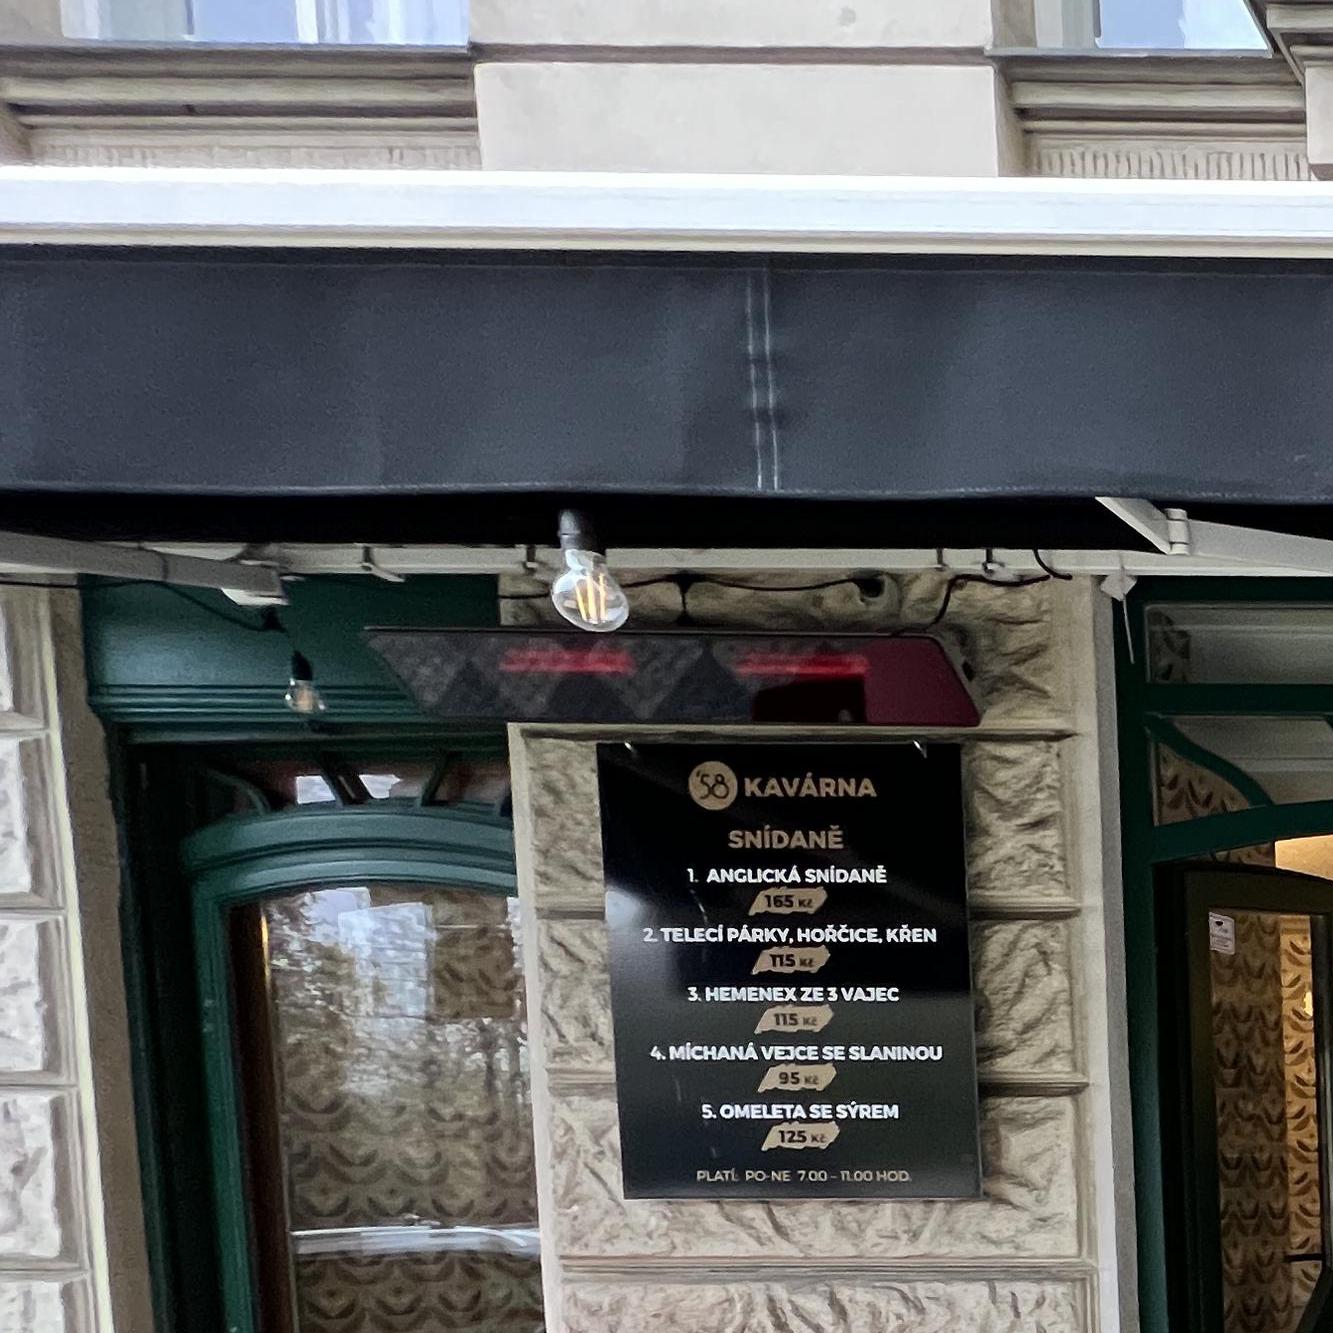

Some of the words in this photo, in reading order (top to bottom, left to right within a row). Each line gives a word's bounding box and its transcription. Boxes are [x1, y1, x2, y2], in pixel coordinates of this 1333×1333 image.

[744, 773, 877, 797] KAVÁRNA
[729, 825, 844, 849] SNÍDANĚ
[687, 869, 698, 883] 1.
[707, 866, 800, 883] ANGLICKÁ
[805, 865, 886, 882] SNÍDANĚ
[765, 895, 794, 908] 165
[644, 929, 658, 943] 2.
[661, 925, 723, 943] TELECÍ
[728, 925, 794, 945] PÁRKY,
[887, 925, 937, 943] KŘEN
[770, 954, 796, 968] 115
[688, 987, 701, 1001] 3.
[705, 987, 797, 1001] HEMENEX
[800, 987, 824, 1001] ZE
[827, 987, 839, 1001] 3
[842, 987, 899, 1001] VAJEC
[774, 1014, 798, 1027] 115
[650, 1047, 666, 1060] 4.
[669, 1042, 758, 1061] MÍCHANÁ
[761, 1047, 819, 1061] VEJCE
[822, 1047, 845, 1060] SE
[849, 1046, 942, 1060] SLANINOU
[778, 1072, 800, 1086] 95
[701, 1105, 717, 1119] 5.
[720, 1105, 807, 1119] OMELETA
[810, 1105, 833, 1119] SE
[836, 1101, 899, 1119] SÝREM
[778, 1130, 807, 1144] 125
[745, 1169, 791, 1182] PO-NE
